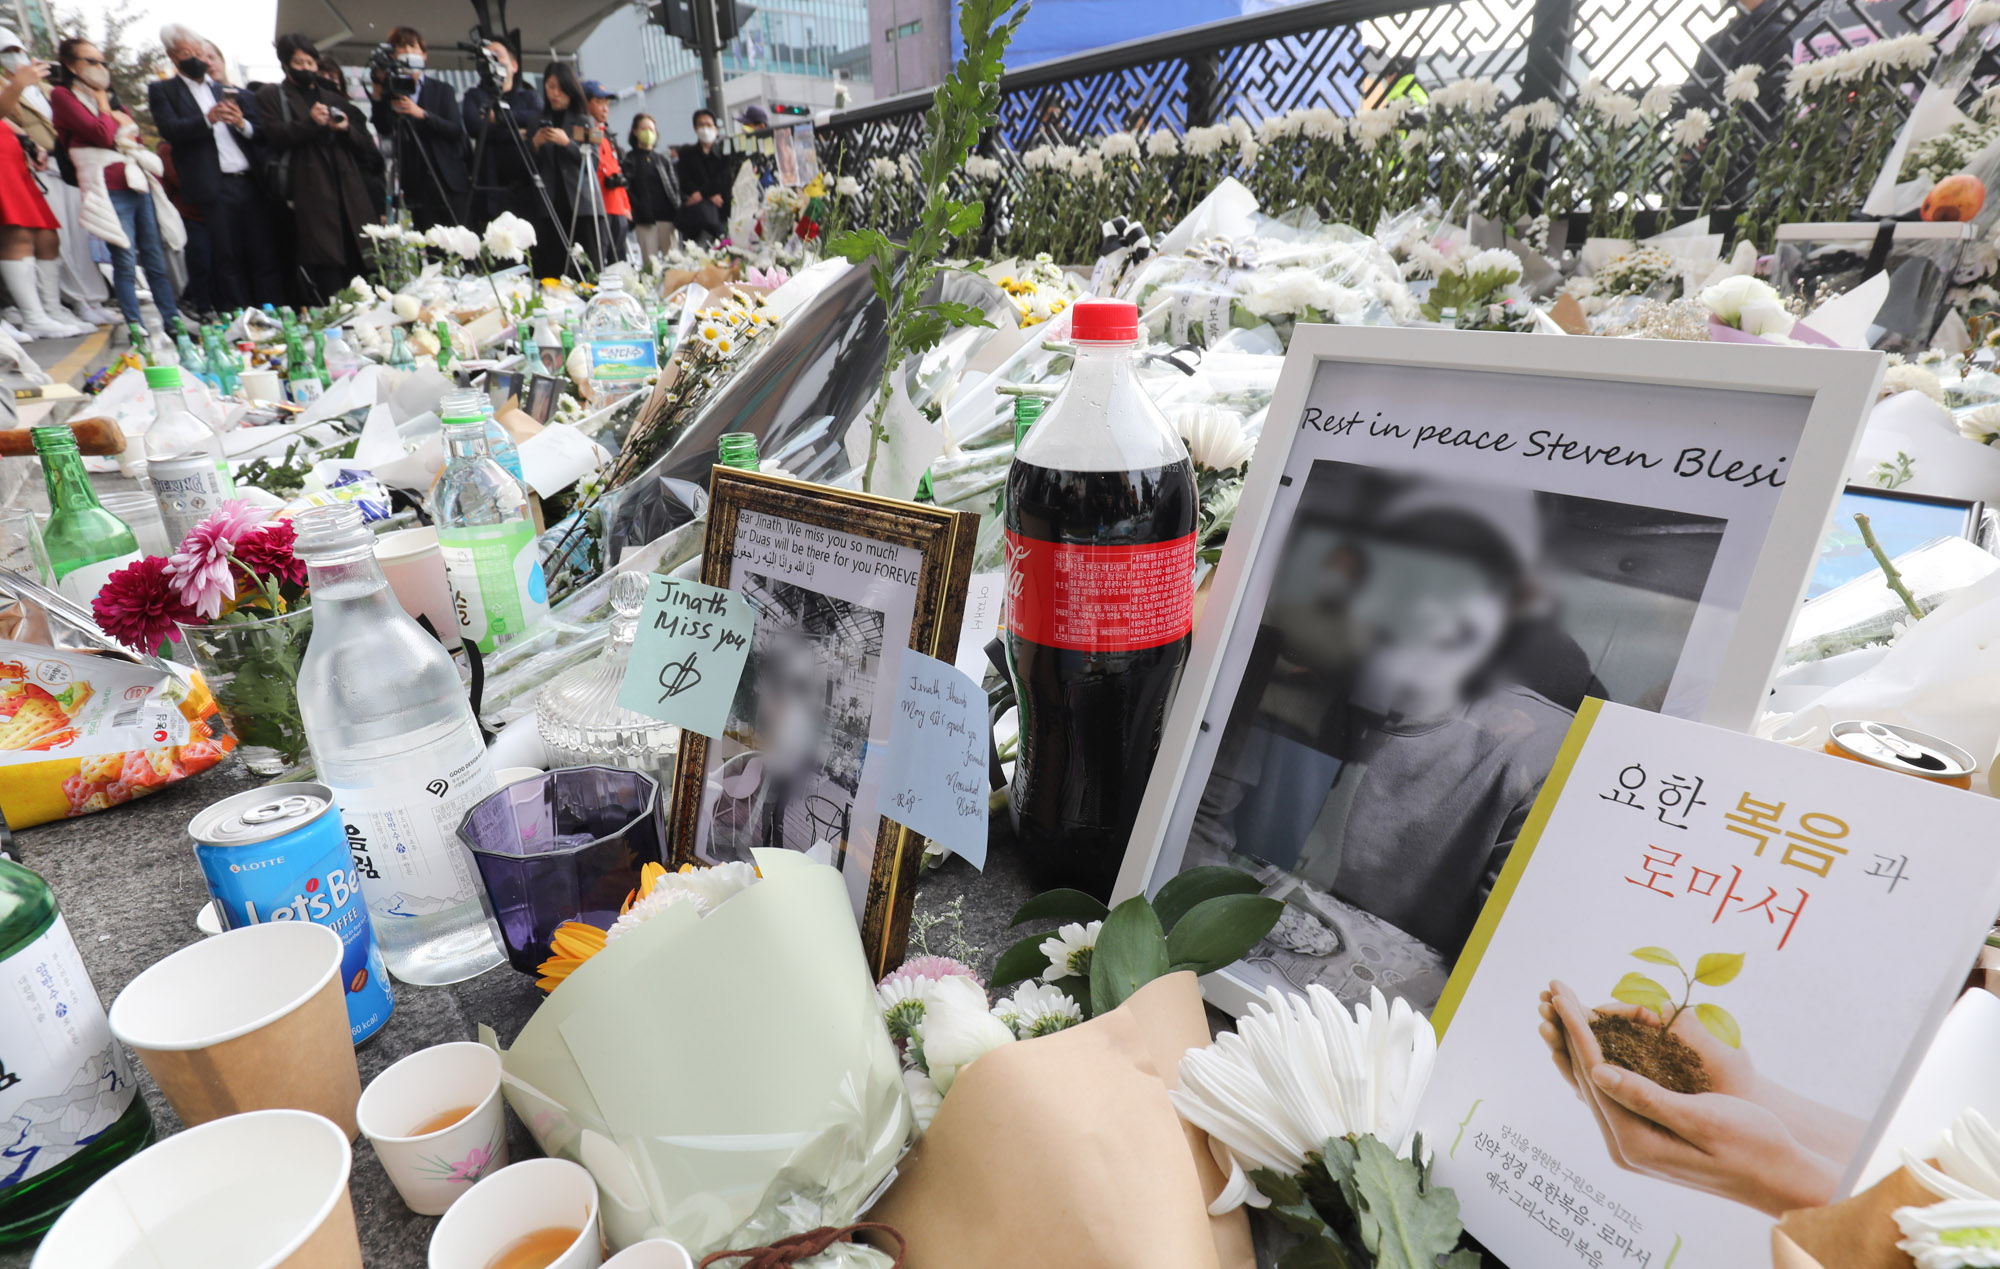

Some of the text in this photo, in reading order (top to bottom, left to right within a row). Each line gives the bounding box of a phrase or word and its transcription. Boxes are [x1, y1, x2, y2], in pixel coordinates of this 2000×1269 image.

[1301, 408, 1787, 488] Rest in peace Steven Blesi
[749, 528, 771, 546] Duas
[774, 537, 790, 551] will
[792, 540, 804, 555] be
[806, 544, 830, 563] there
[833, 551, 849, 567] for
[851, 559, 872, 574] you
[755, 515, 783, 534] Jinath,
[787, 521, 802, 537] We
[804, 527, 825, 543] miss
[826, 533, 847, 549] you
[850, 540, 863, 552] so
[866, 544, 899, 562] much!
[656, 580, 728, 617] Jinath
[653, 609, 746, 652] Miss you
[155, 713, 168, 730] 농심
[449, 765, 466, 778] GOOD
[384, 810, 400, 841] 암반수
[1597, 762, 1910, 895] 요한 복음 과
[243, 856, 286, 872] LOTTE
[329, 906, 359, 933] OFFEE
[1623, 844, 1810, 951] 로마서
[1473, 1131, 1501, 1160] 신약
[1500, 1150, 1528, 1180] 성경
[1500, 1123, 1645, 1234] 당신을 영원한 구원으로 이끄는
[1485, 1171, 1606, 1269] 예수 그리스도의 복음
